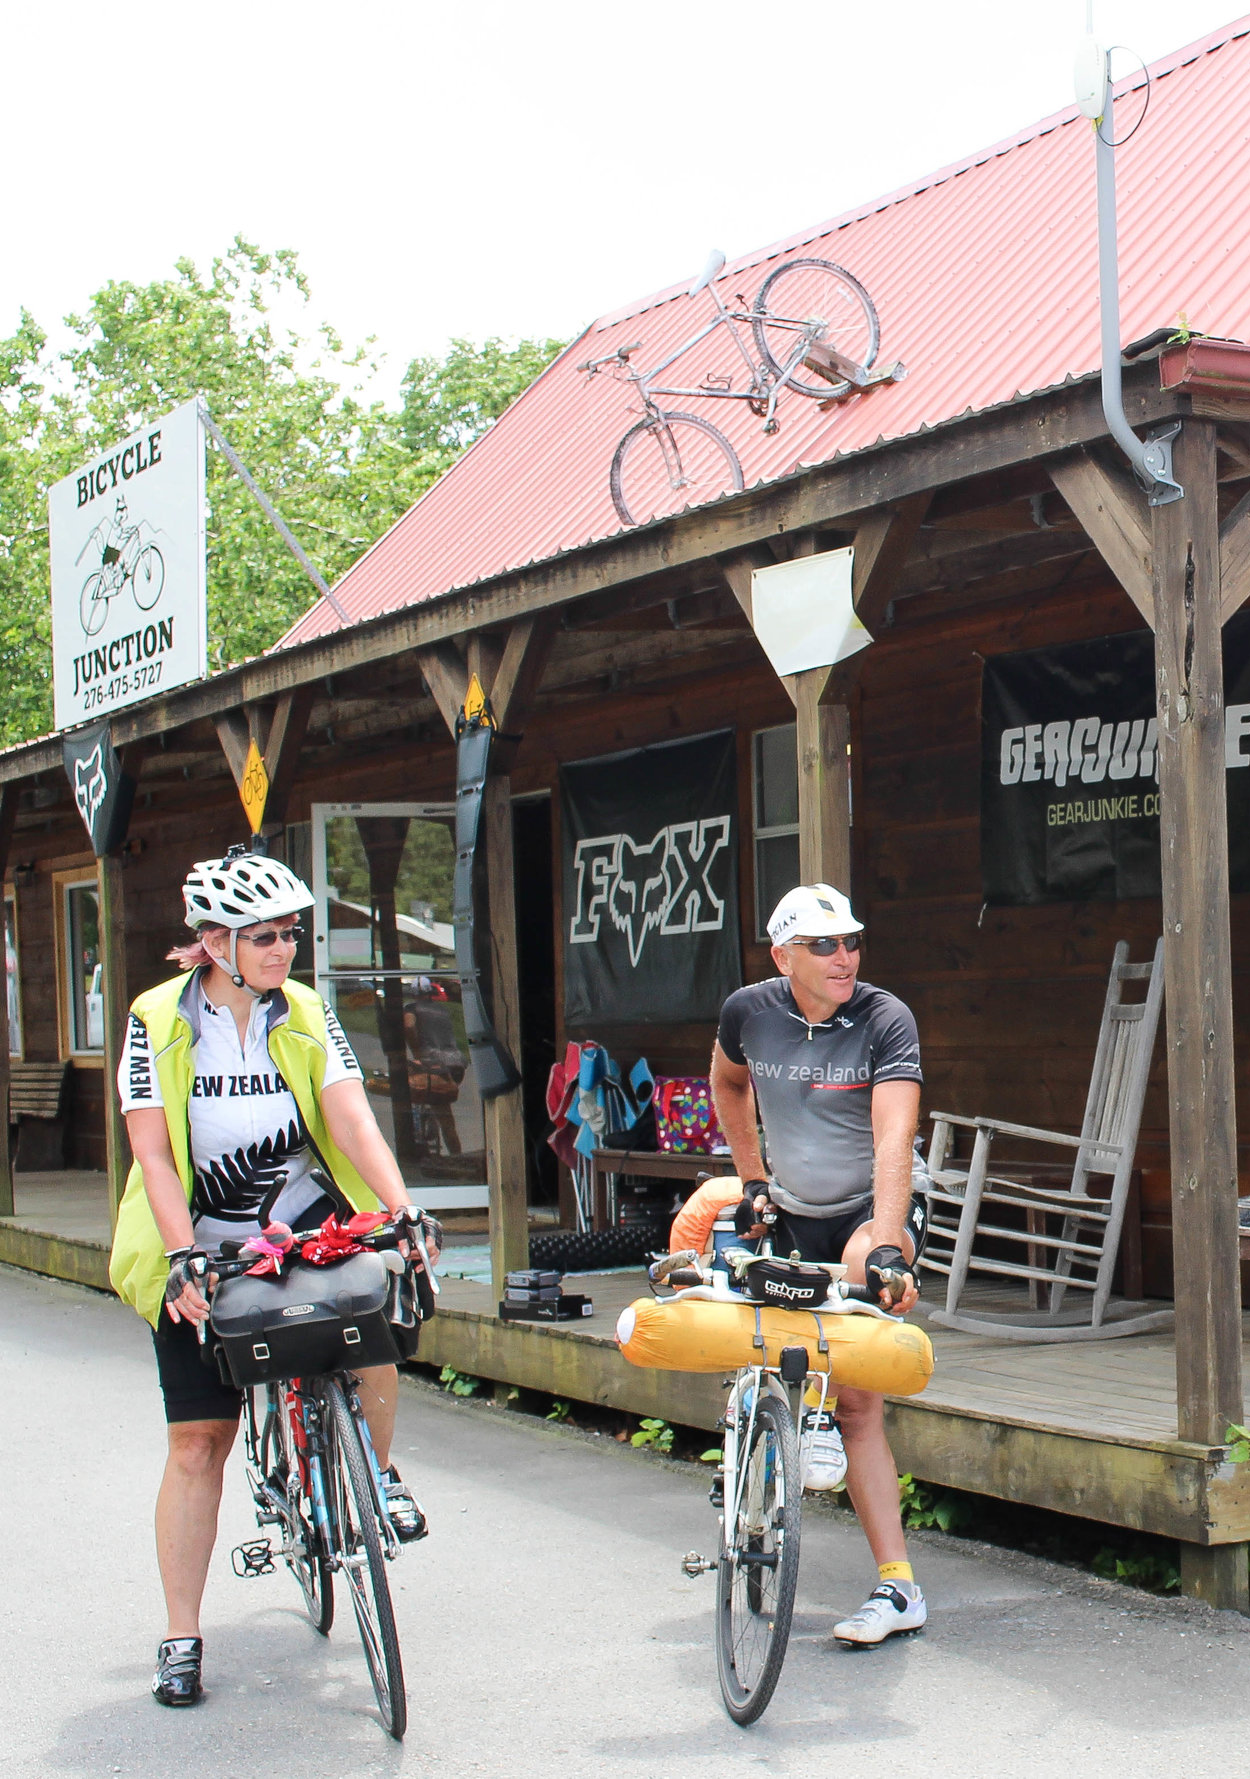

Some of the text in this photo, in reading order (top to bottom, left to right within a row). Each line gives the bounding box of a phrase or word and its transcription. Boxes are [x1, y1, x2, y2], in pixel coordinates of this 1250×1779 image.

[76, 429, 162, 509] BICYCLE
[73, 615, 174, 697] JUNCTION
[83, 660, 163, 710] 276-475-5727
[1047, 793, 1161, 827] GEARJUNKIE.CO
[130, 1055, 153, 1100] NEW
[191, 1072, 290, 1098] EW ZEALA
[747, 1059, 783, 1080] new
[788, 1062, 871, 1083] zealand
